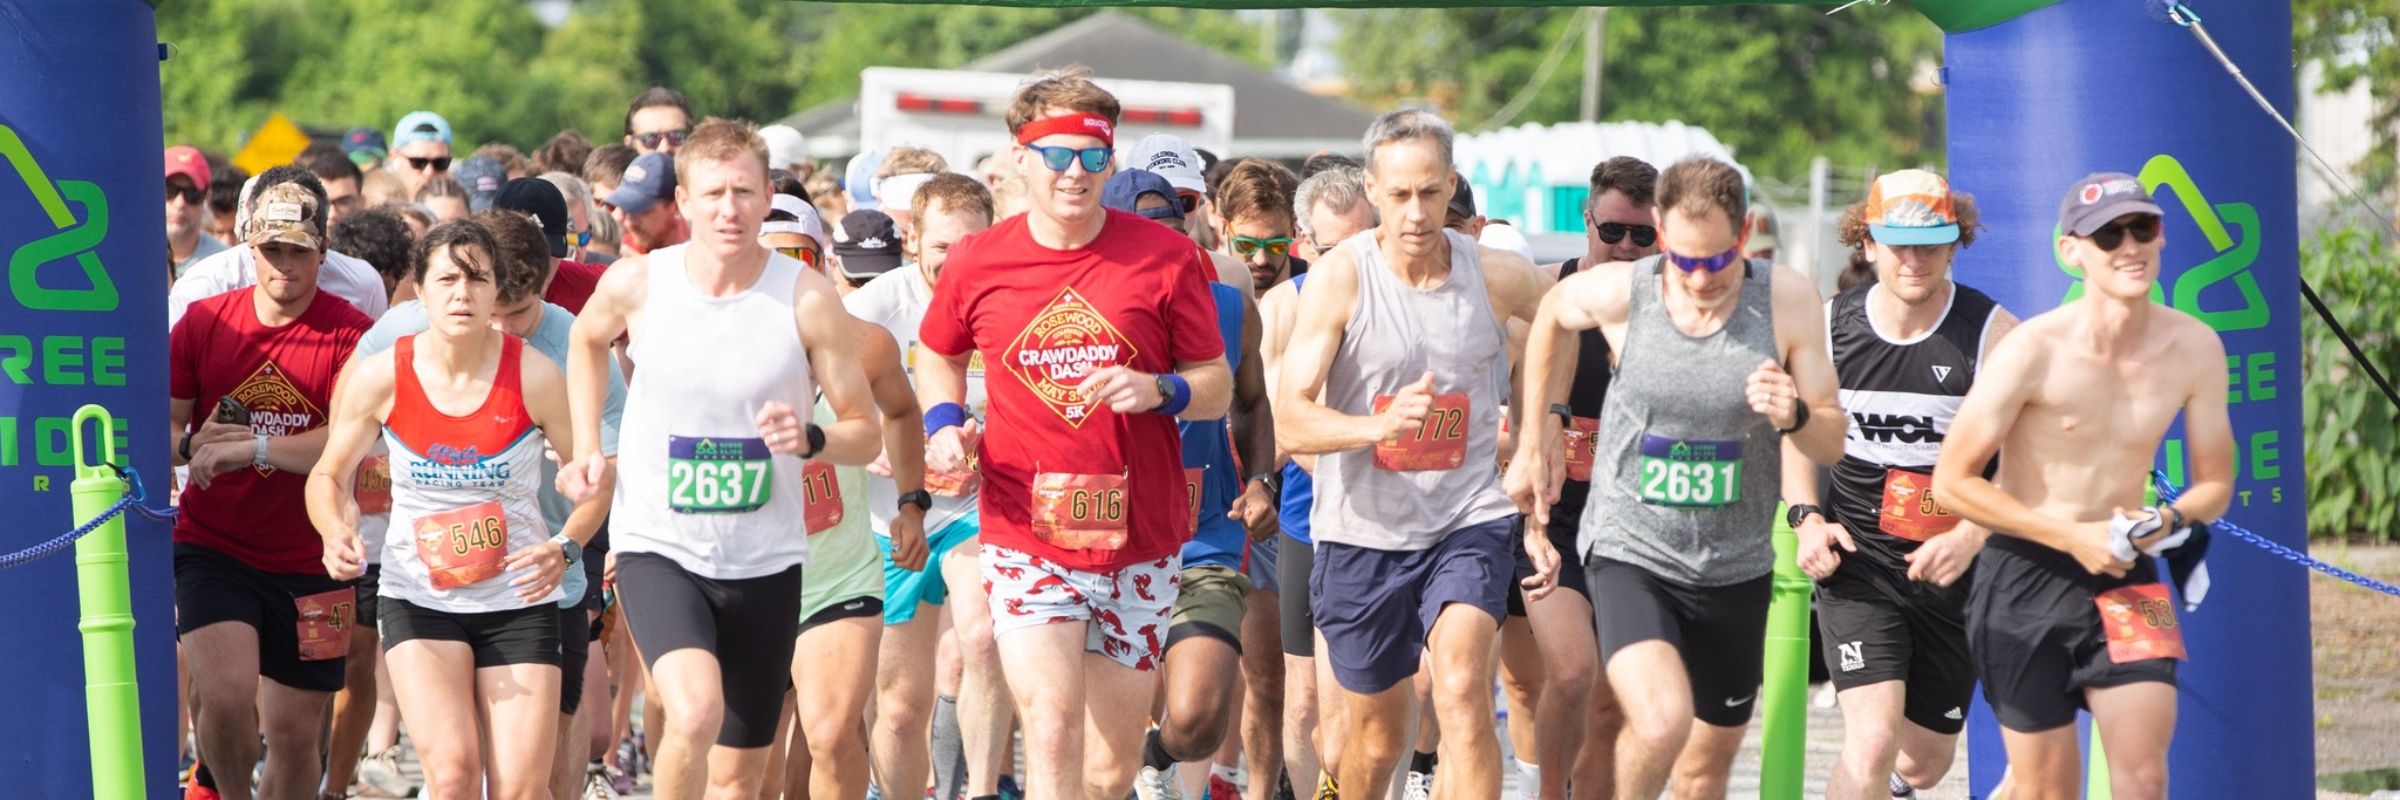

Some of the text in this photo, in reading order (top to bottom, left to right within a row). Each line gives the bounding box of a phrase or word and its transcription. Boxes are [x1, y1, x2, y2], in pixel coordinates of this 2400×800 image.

[1033, 311, 1102, 339] ROSEWOOD
[1018, 344, 1119, 366] CRAWDADDY
[238, 382, 299, 405] ROSEWOOD
[1037, 378, 1067, 401] MAY
[1065, 405, 1086, 418] 5K
[409, 461, 511, 480] RUNNING
[1644, 459, 1736, 503] 2631
[671, 461, 767, 506] 2637
[1071, 488, 1122, 522] 616
[449, 515, 504, 557] 546
